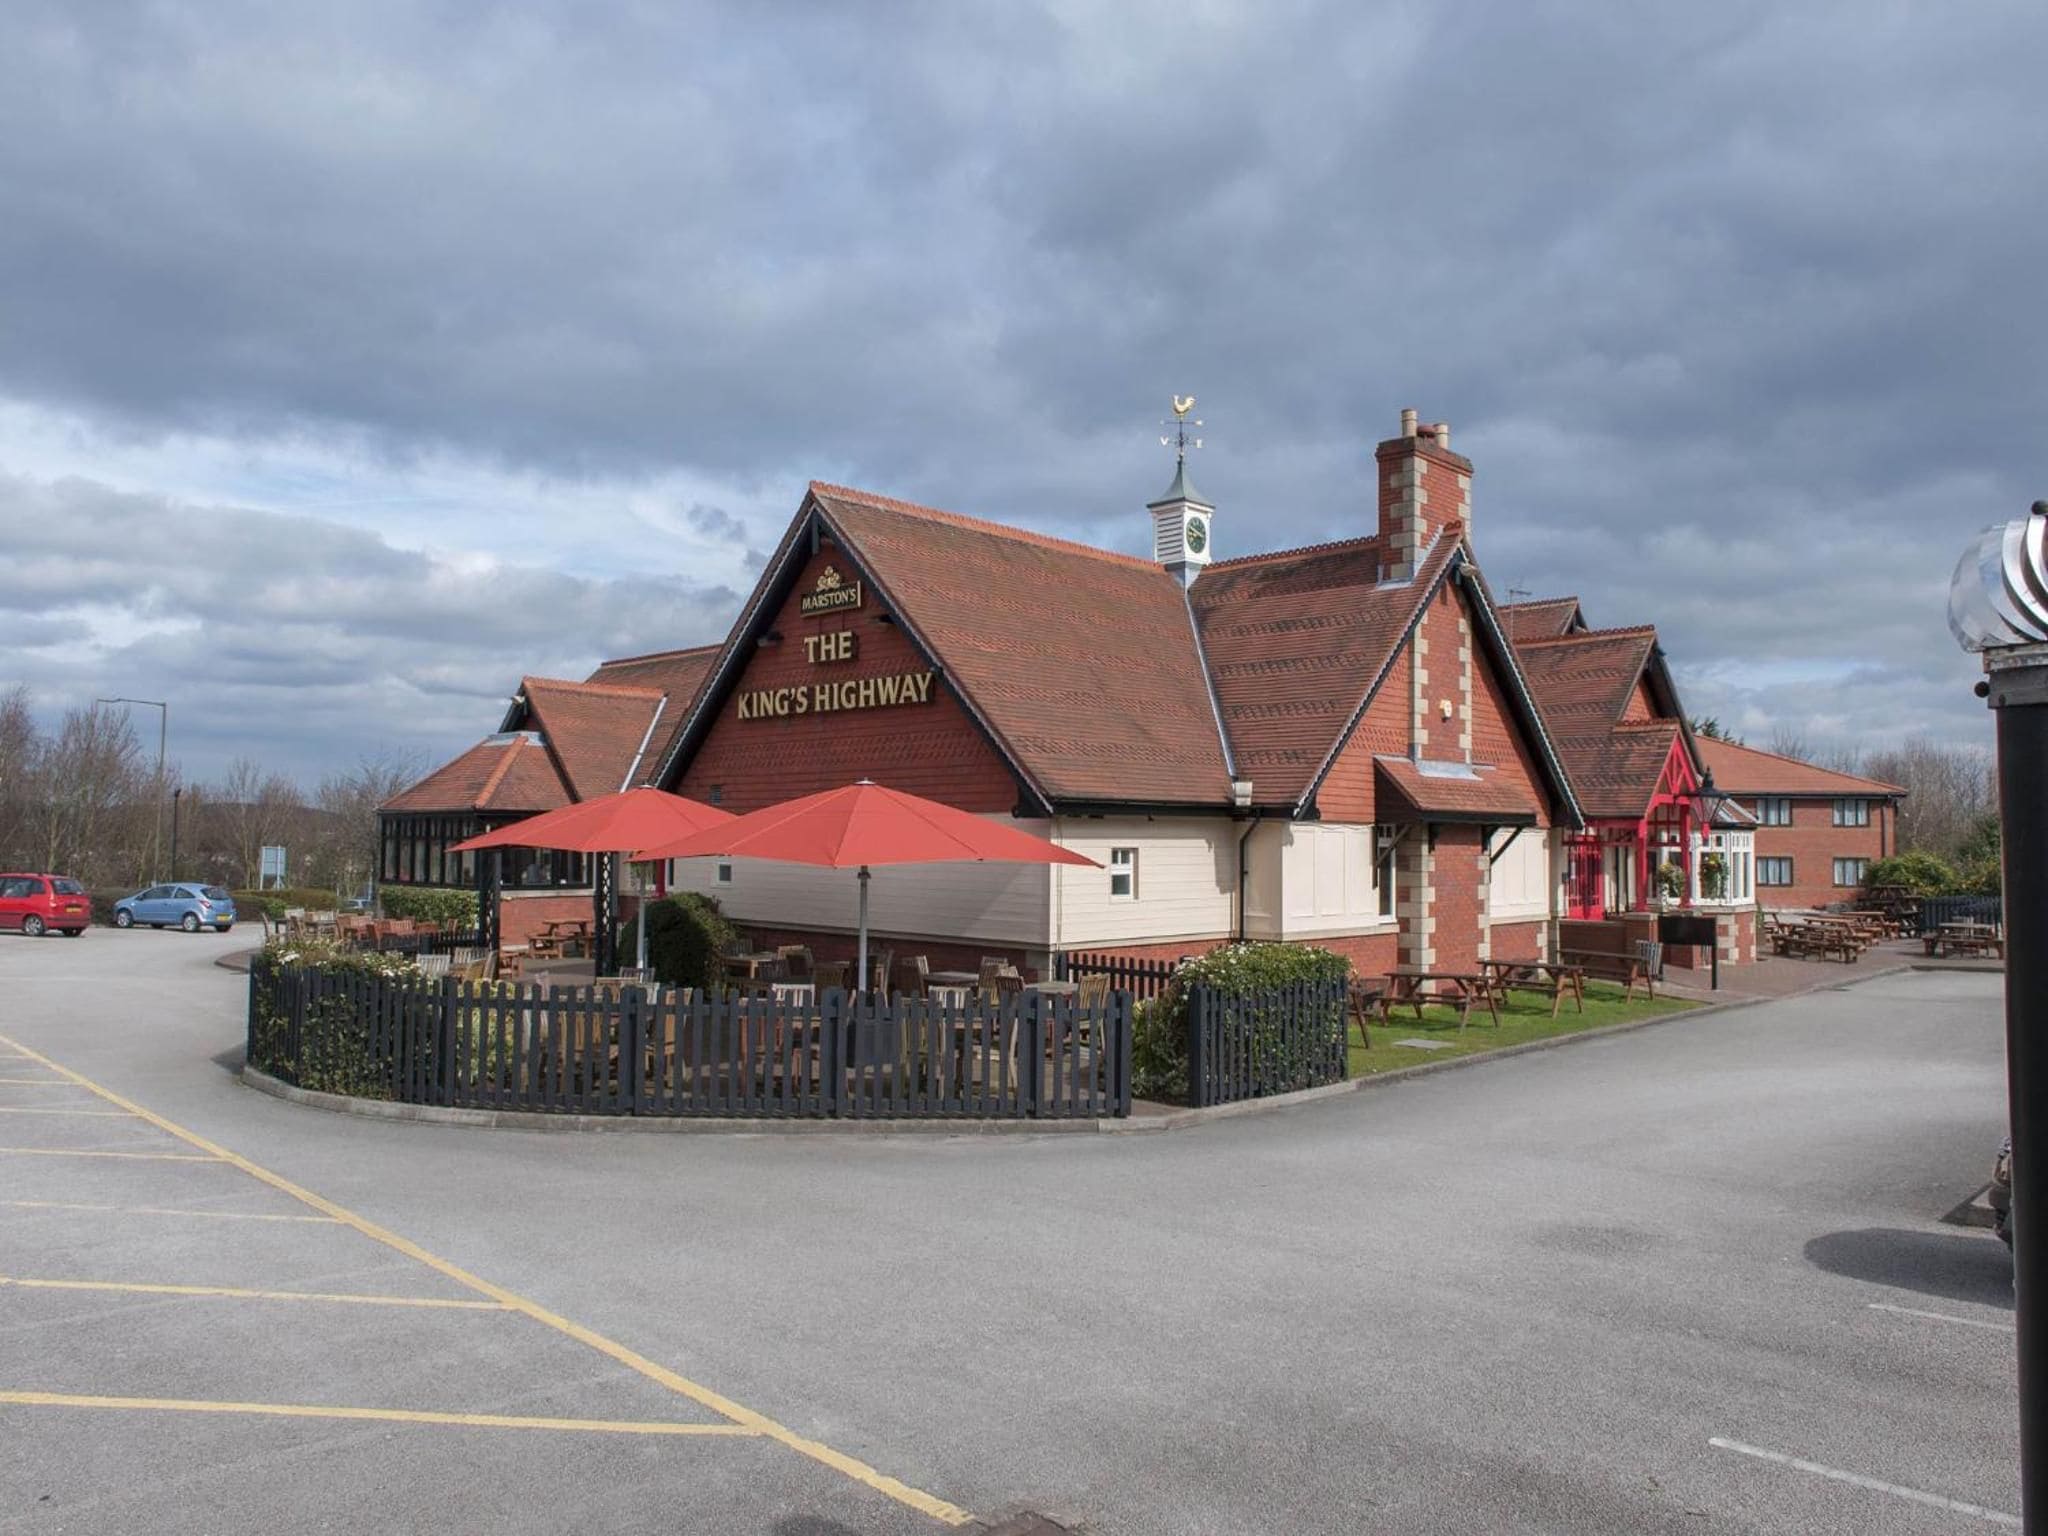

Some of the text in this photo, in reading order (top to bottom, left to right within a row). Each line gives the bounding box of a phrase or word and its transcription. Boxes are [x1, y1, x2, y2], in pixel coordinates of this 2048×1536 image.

[802, 587, 857, 610] MARSTON'S
[804, 632, 853, 663] THE
[738, 672, 932, 719] KING'S HIGHWAY
